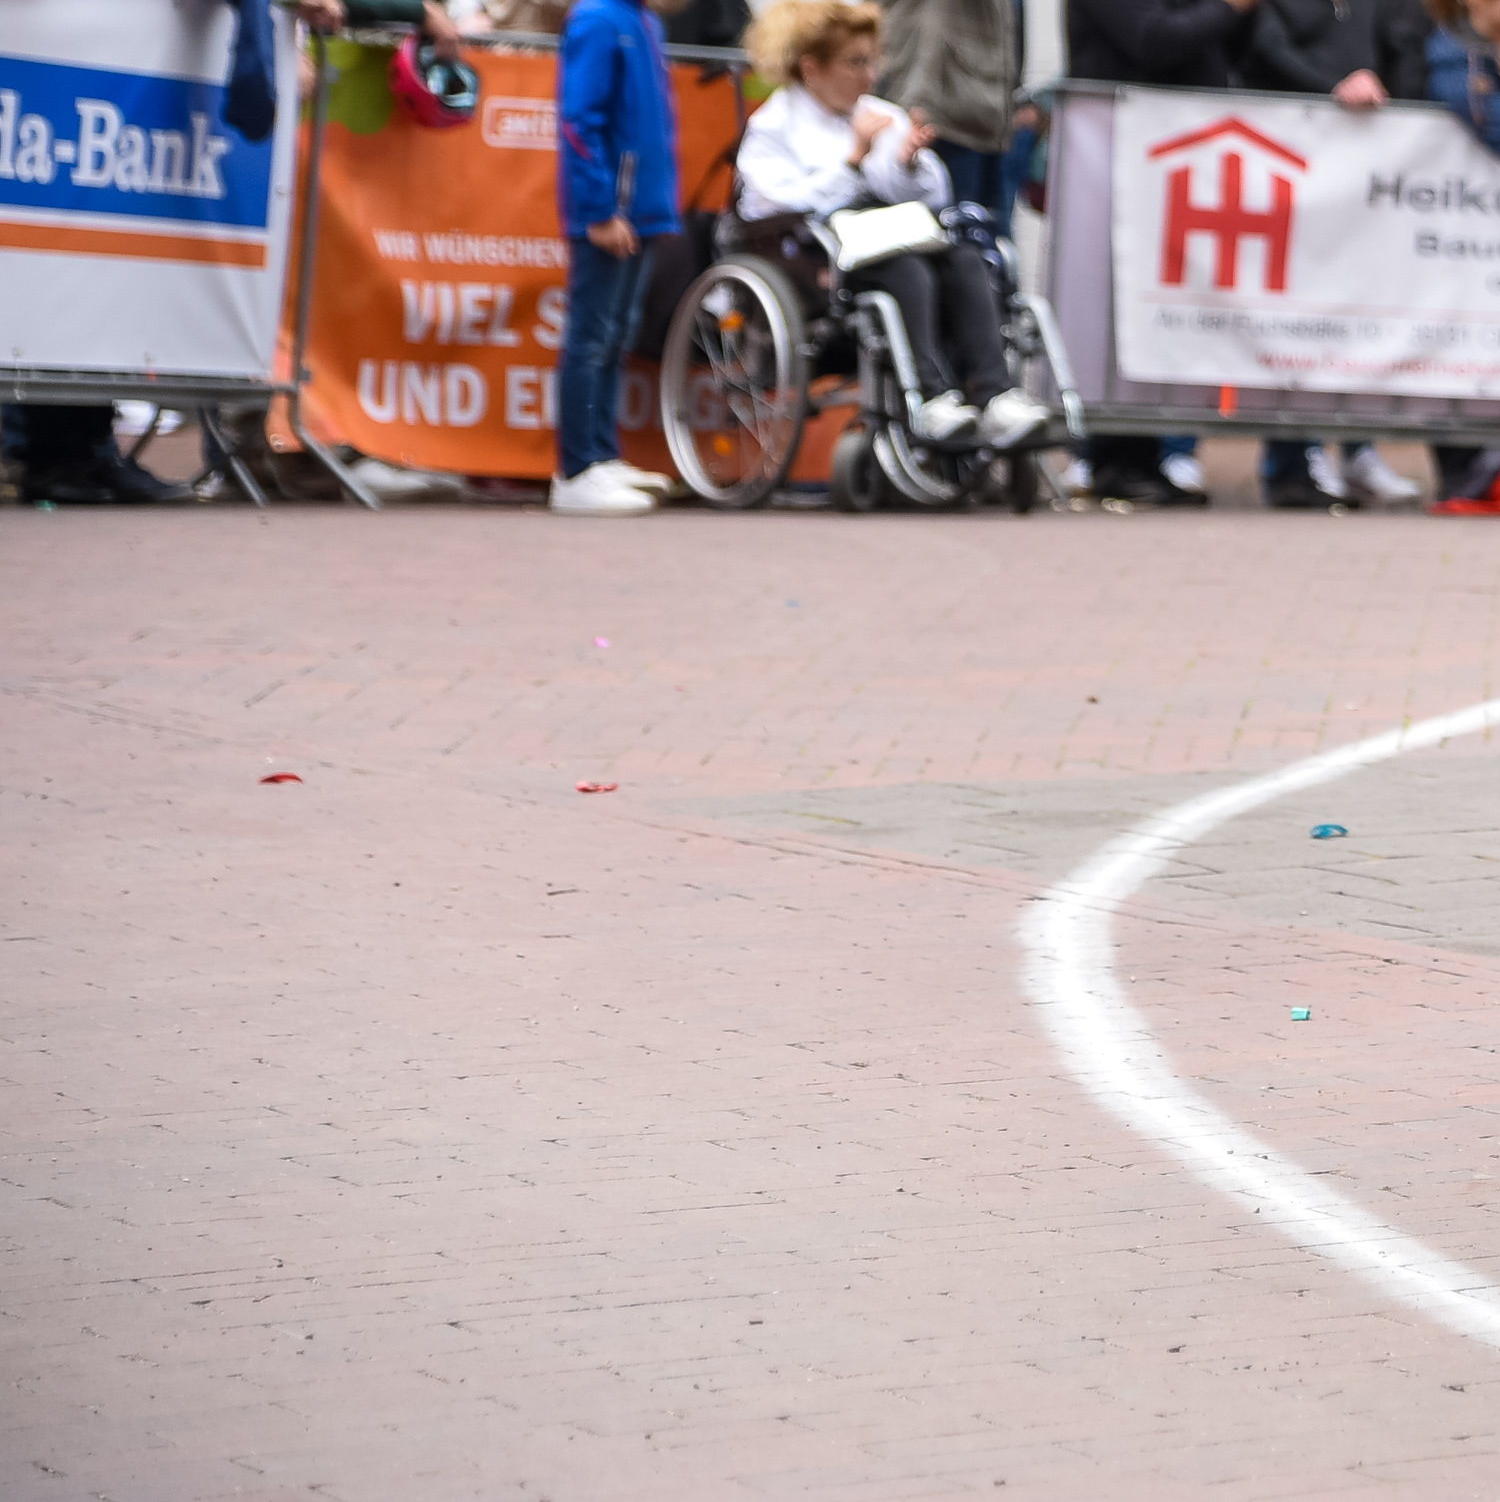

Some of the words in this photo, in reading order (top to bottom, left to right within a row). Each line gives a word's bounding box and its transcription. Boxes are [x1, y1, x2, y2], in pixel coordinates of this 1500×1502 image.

[373, 227, 419, 262] WIR
[401, 279, 521, 348] VIEL
[357, 358, 487, 428] UND
